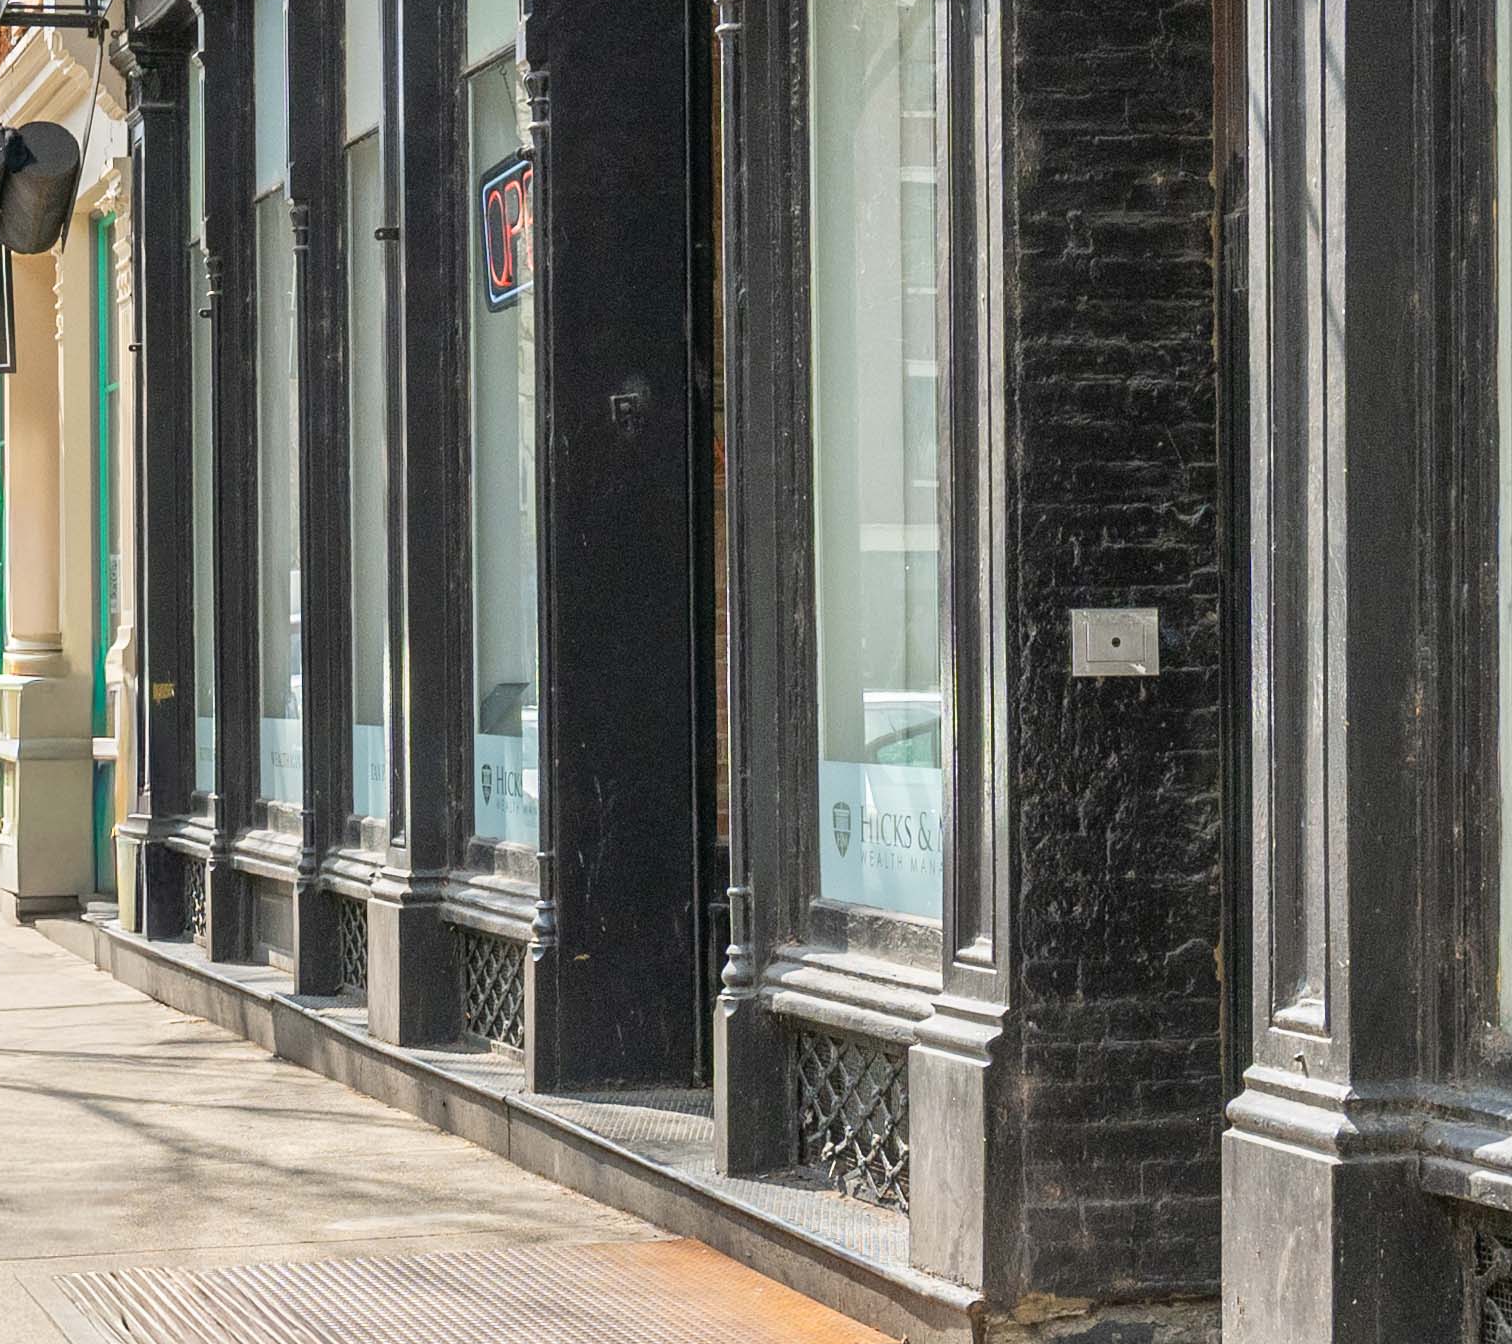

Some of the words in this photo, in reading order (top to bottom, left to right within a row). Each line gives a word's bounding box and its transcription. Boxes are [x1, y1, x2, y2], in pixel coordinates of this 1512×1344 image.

[860, 805, 912, 849] HICKS
[917, 811, 934, 852] &
[860, 849, 904, 870] WEALTH
